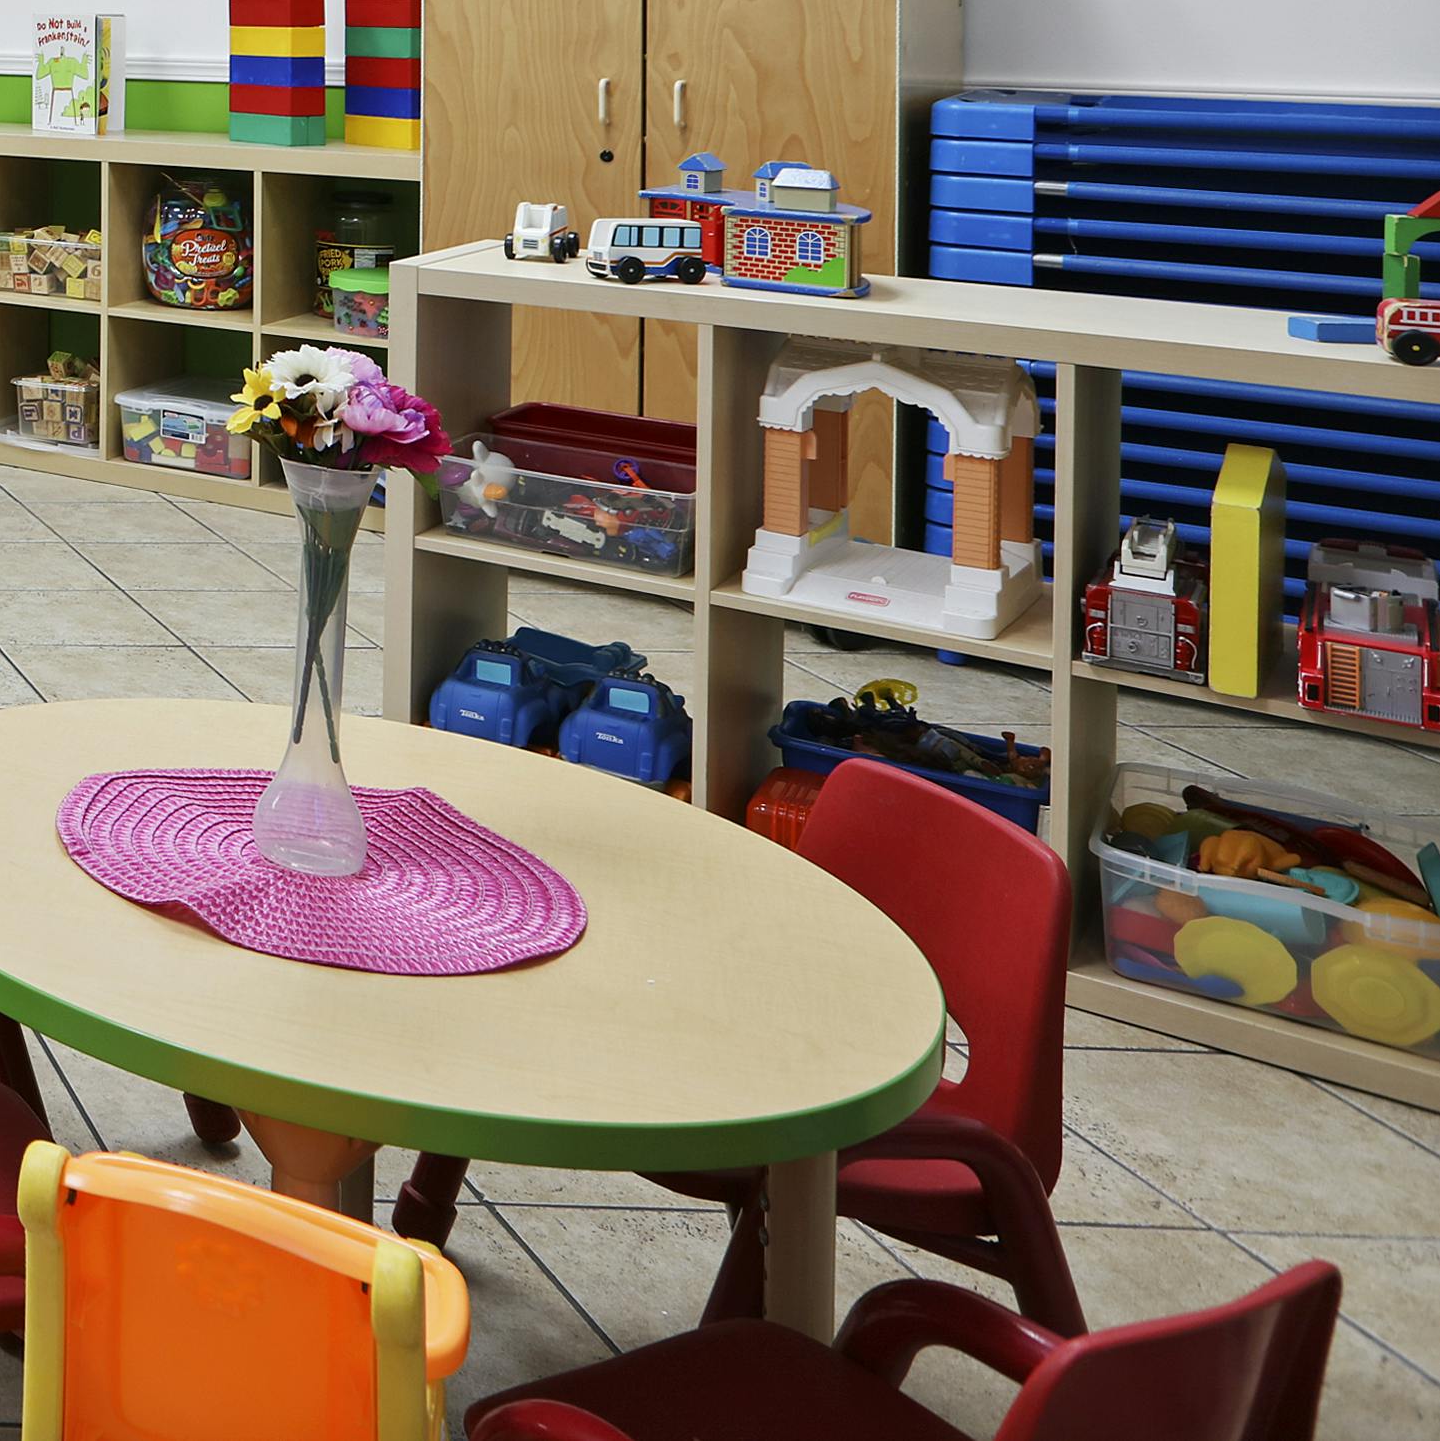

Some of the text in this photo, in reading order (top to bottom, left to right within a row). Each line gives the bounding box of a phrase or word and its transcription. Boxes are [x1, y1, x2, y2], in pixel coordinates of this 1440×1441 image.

[37, 23, 46, 31] Do
[67, 20, 82, 29] Build
[181, 239, 227, 257] Pretzel
[319, 249, 342, 259] FRIED
[189, 254, 221, 266] Treats
[319, 259, 343, 268] PORK
[459, 709, 485, 721] Tonka
[595, 732, 624, 745] Tonka
